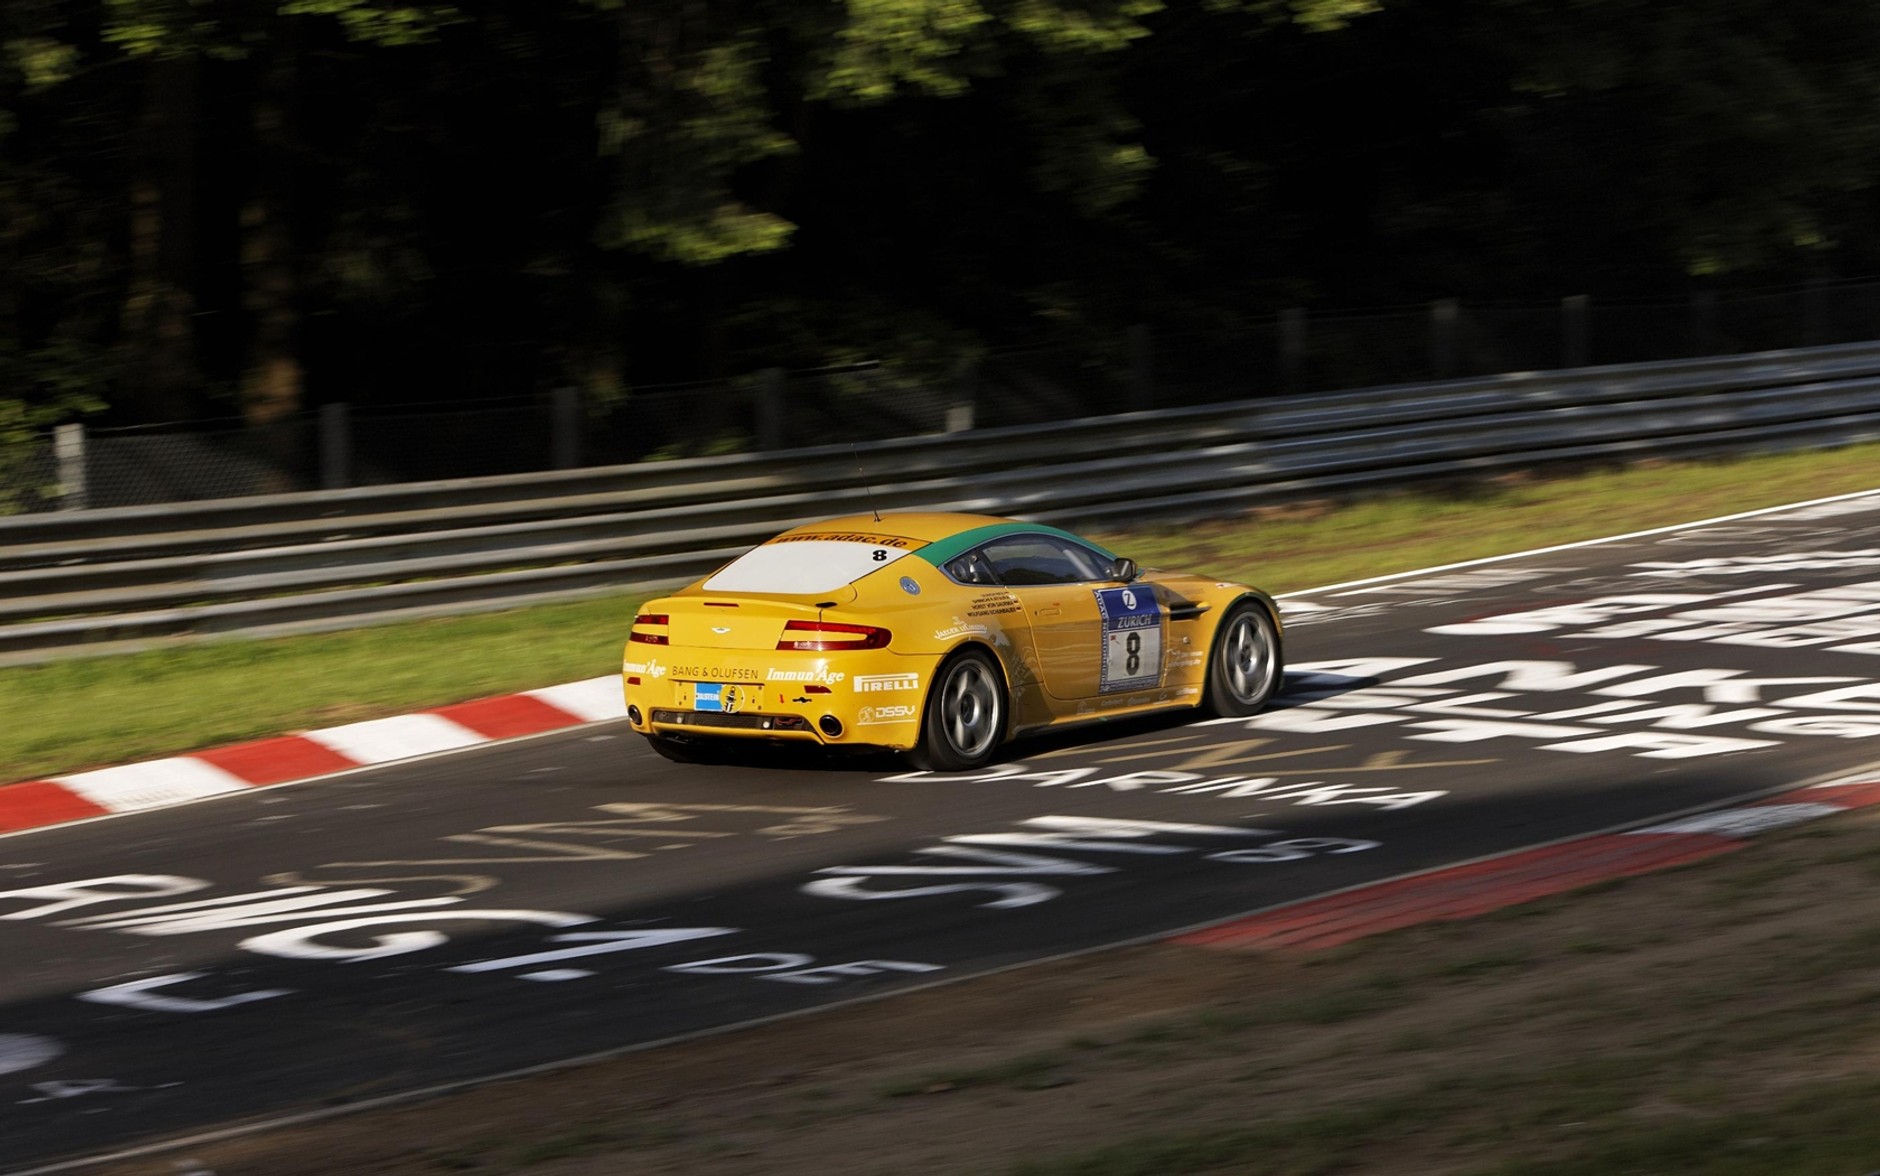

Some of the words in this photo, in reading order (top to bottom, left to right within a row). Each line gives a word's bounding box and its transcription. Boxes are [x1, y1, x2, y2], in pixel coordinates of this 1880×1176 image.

[776, 533, 908, 548] www.adac.de
[872, 549, 887, 562] 8
[1126, 631, 1141, 676] 8
[672, 665, 699, 677] BANG
[702, 667, 709, 677] &
[710, 667, 759, 679] OLUFSEN
[853, 672, 919, 692] PIRELLI
